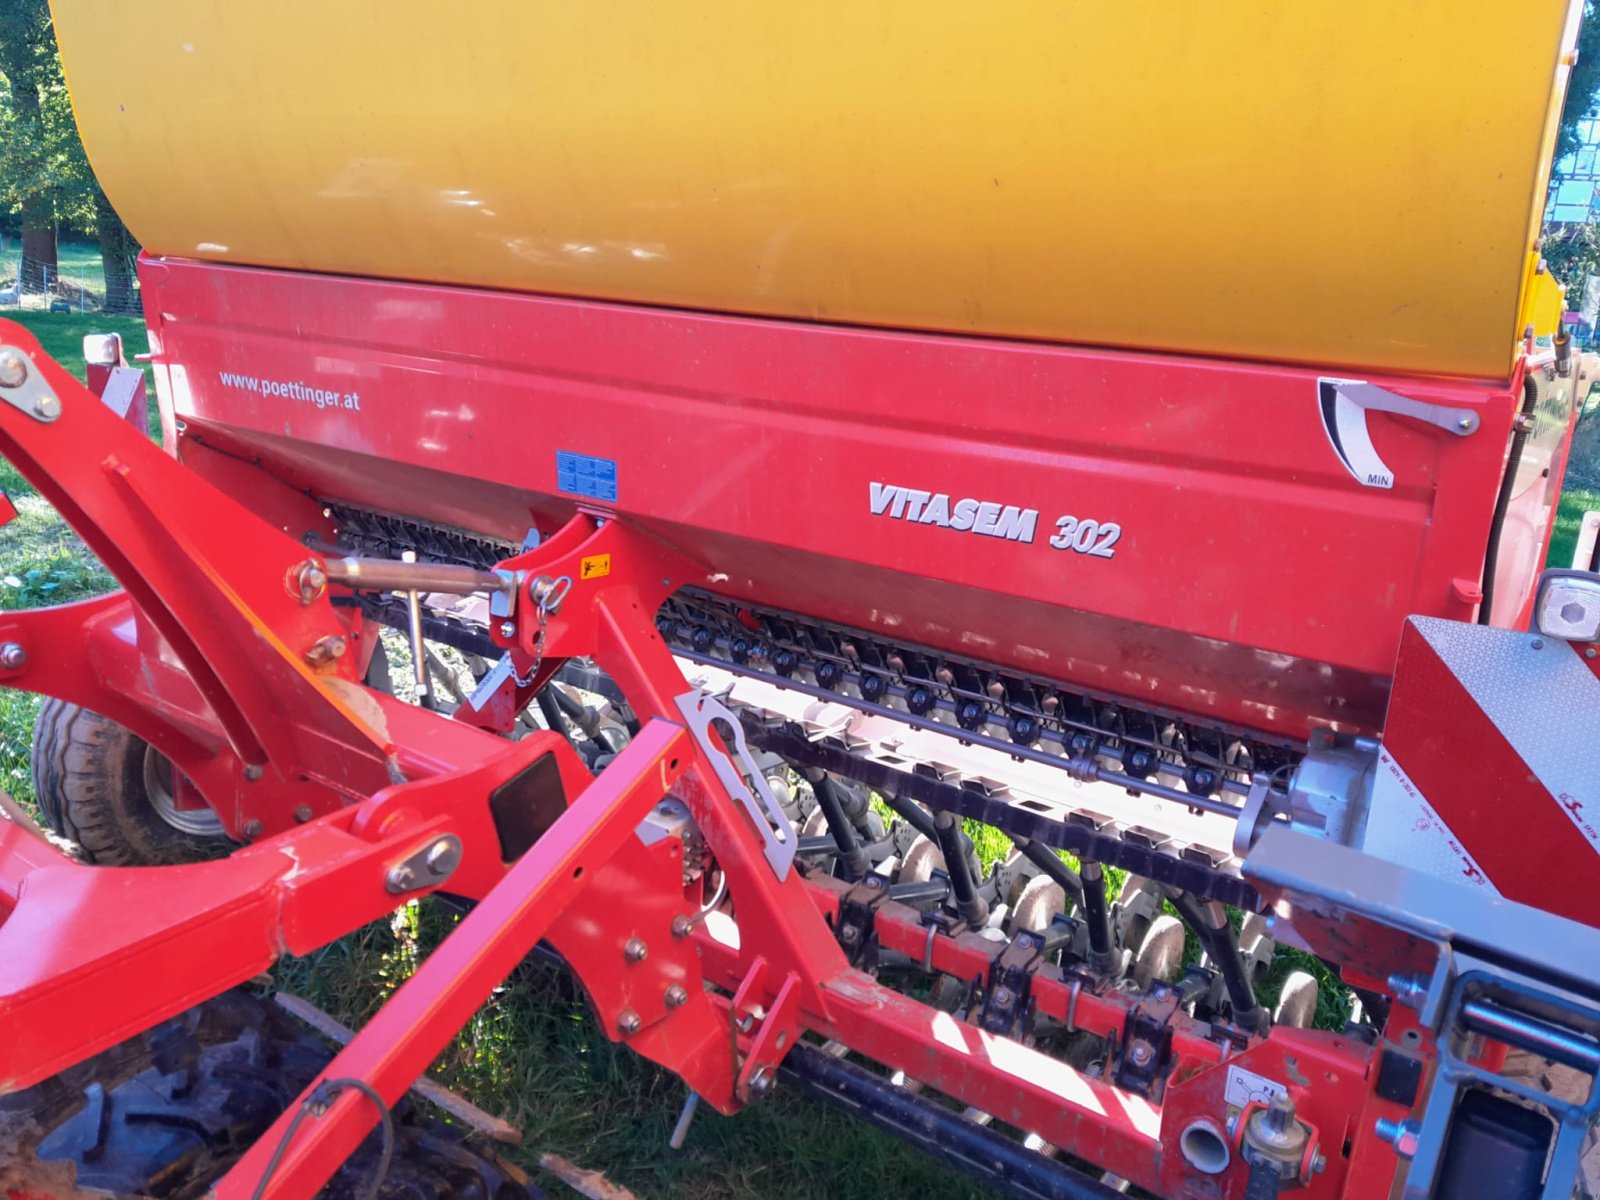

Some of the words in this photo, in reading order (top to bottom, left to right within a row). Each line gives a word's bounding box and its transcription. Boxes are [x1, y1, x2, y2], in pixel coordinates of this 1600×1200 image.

[219, 371, 360, 409] www.poettinger.at
[1367, 474, 1389, 486] MIN
[869, 482, 1039, 543] VITASEM
[1050, 515, 1121, 557] 302
